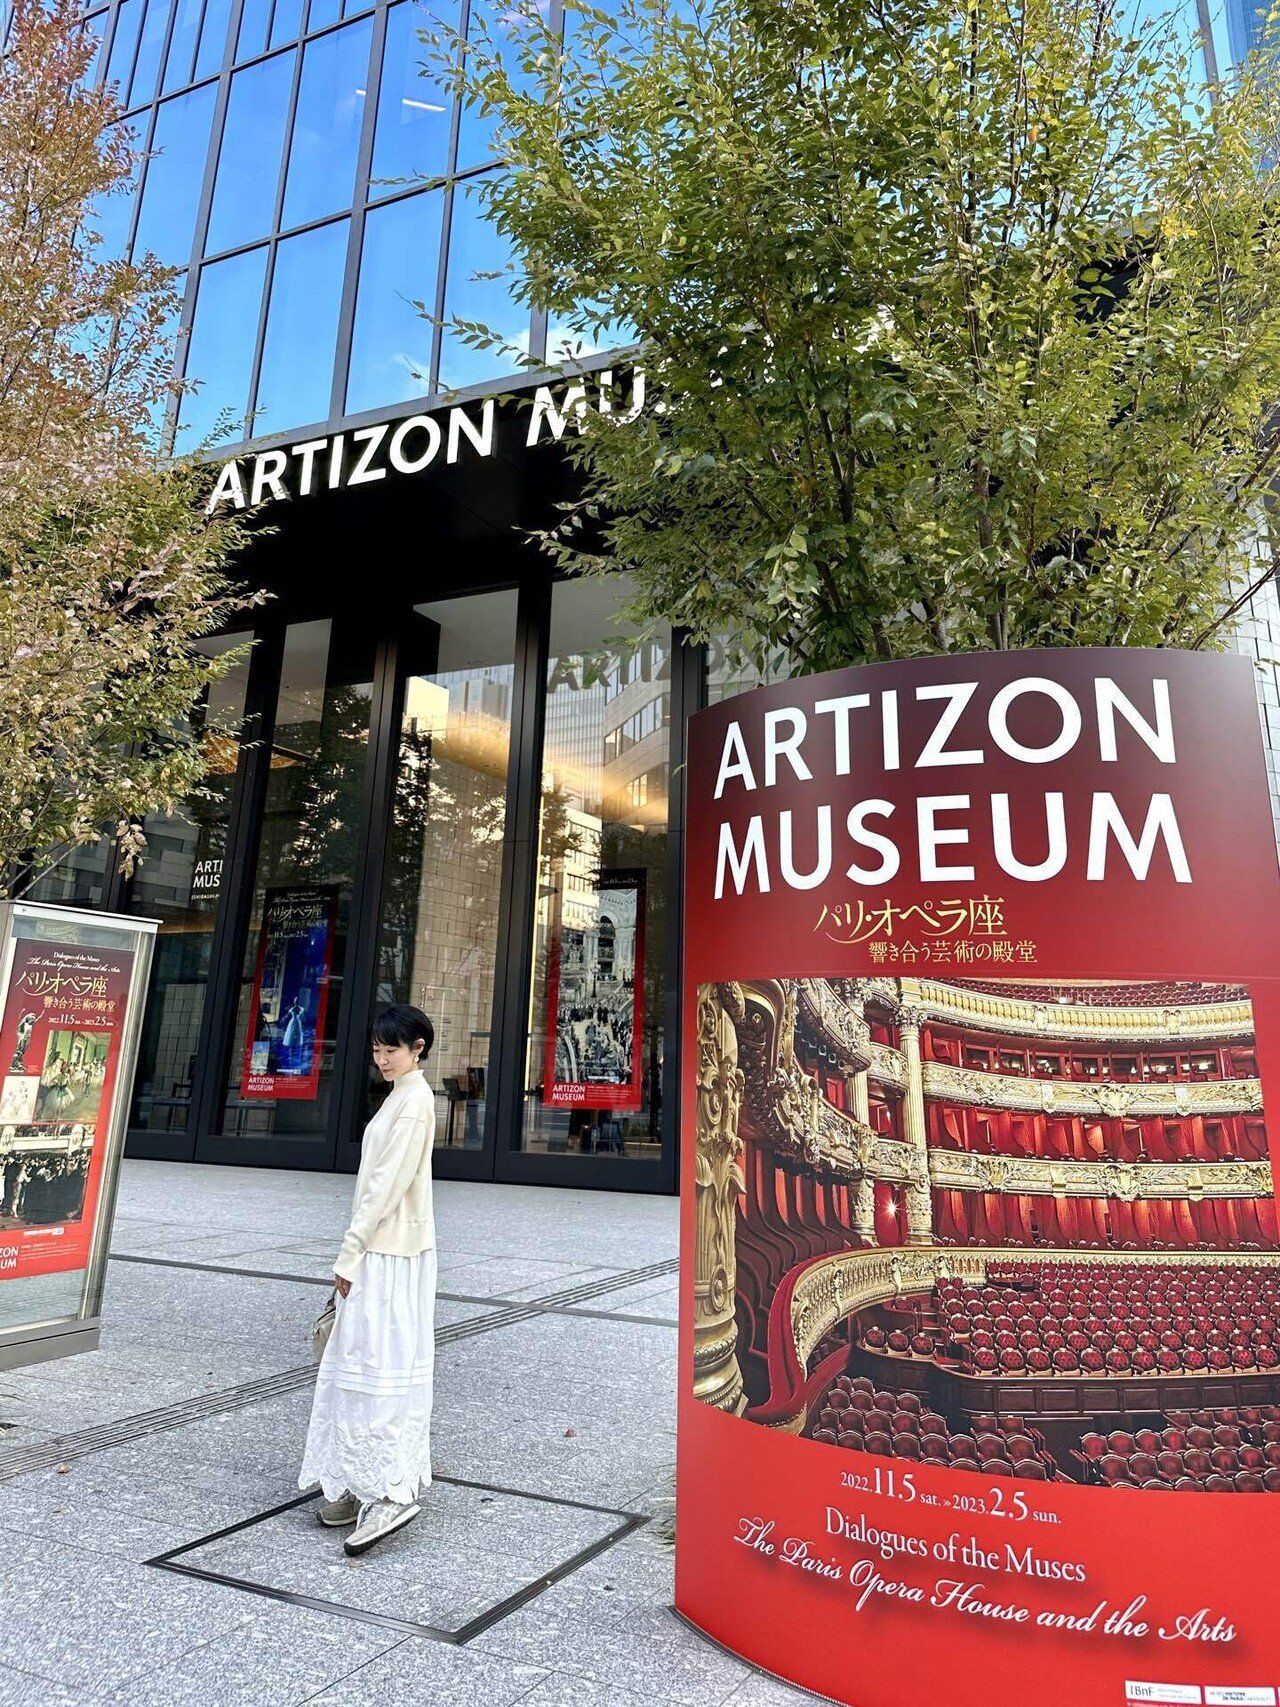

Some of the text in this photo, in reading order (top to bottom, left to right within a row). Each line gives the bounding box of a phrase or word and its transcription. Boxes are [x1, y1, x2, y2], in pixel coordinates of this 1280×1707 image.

[204, 399, 496, 515] ARTIZON
[714, 677, 1177, 800] ARTIZON
[714, 792, 1193, 900] MUSEUM
[813, 893, 1008, 944] パリ・オペラ座
[868, 939, 1038, 964] 響き合う芸術の殿堂
[14, 970, 109, 998] パリ・オペラ座
[247, 1084, 273, 1092] MUSEUM
[248, 1076, 274, 1084] ARTIZON
[552, 1084, 586, 1093] ARTIZON
[552, 1092, 585, 1101] MUSEUM
[840, 1467, 917, 1502] 2022.11.5
[920, 1492, 941, 1506] sat.
[1032, 1510, 1062, 1524] sun.
[826, 1506, 1086, 1582] Dialogues of the Muses
[733, 1516, 1237, 1642] The Paris Opera House and the Arts
